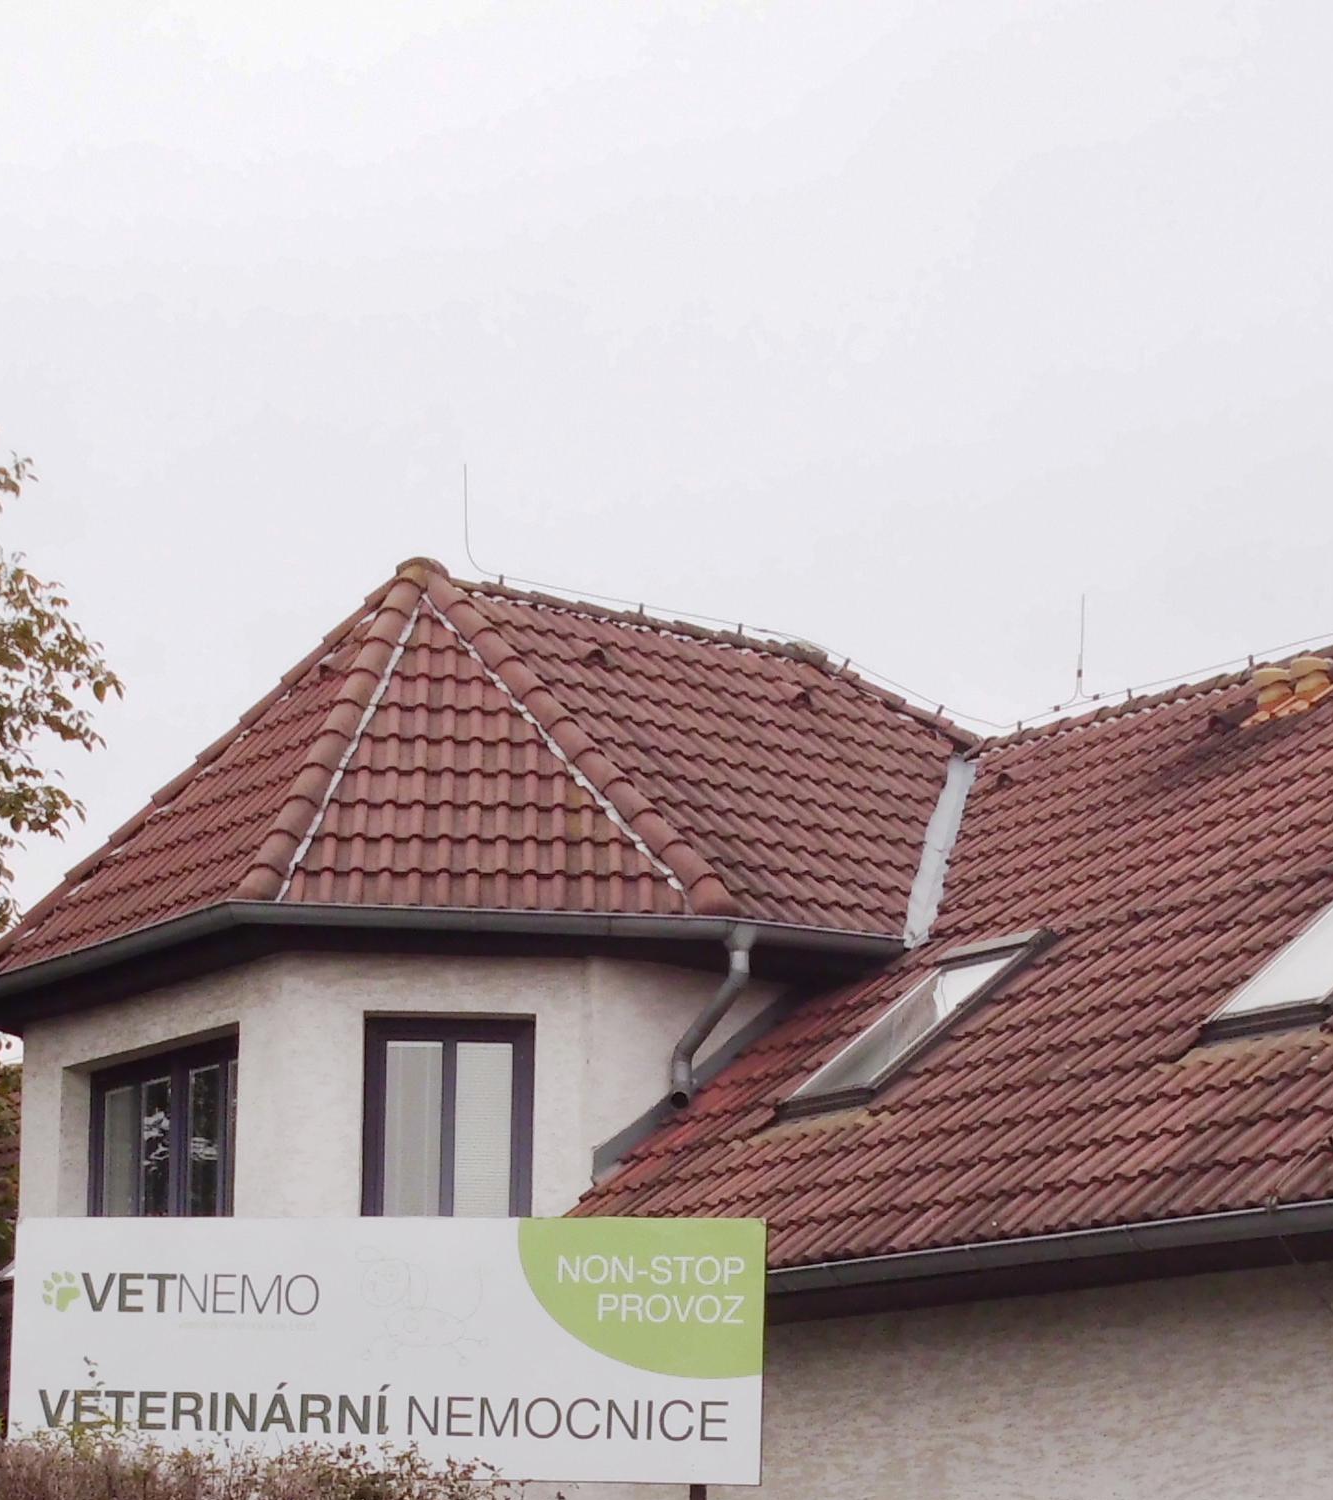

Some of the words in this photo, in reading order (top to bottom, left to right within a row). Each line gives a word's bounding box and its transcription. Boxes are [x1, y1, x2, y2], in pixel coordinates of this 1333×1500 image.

[556, 1253, 746, 1286] NON-STOP
[80, 1272, 320, 1316] VETNEMO
[597, 1292, 746, 1325] PROVOZ
[38, 1381, 391, 1435] VETERINÁRNÍ
[406, 1394, 730, 1442] NEMOCNICE
